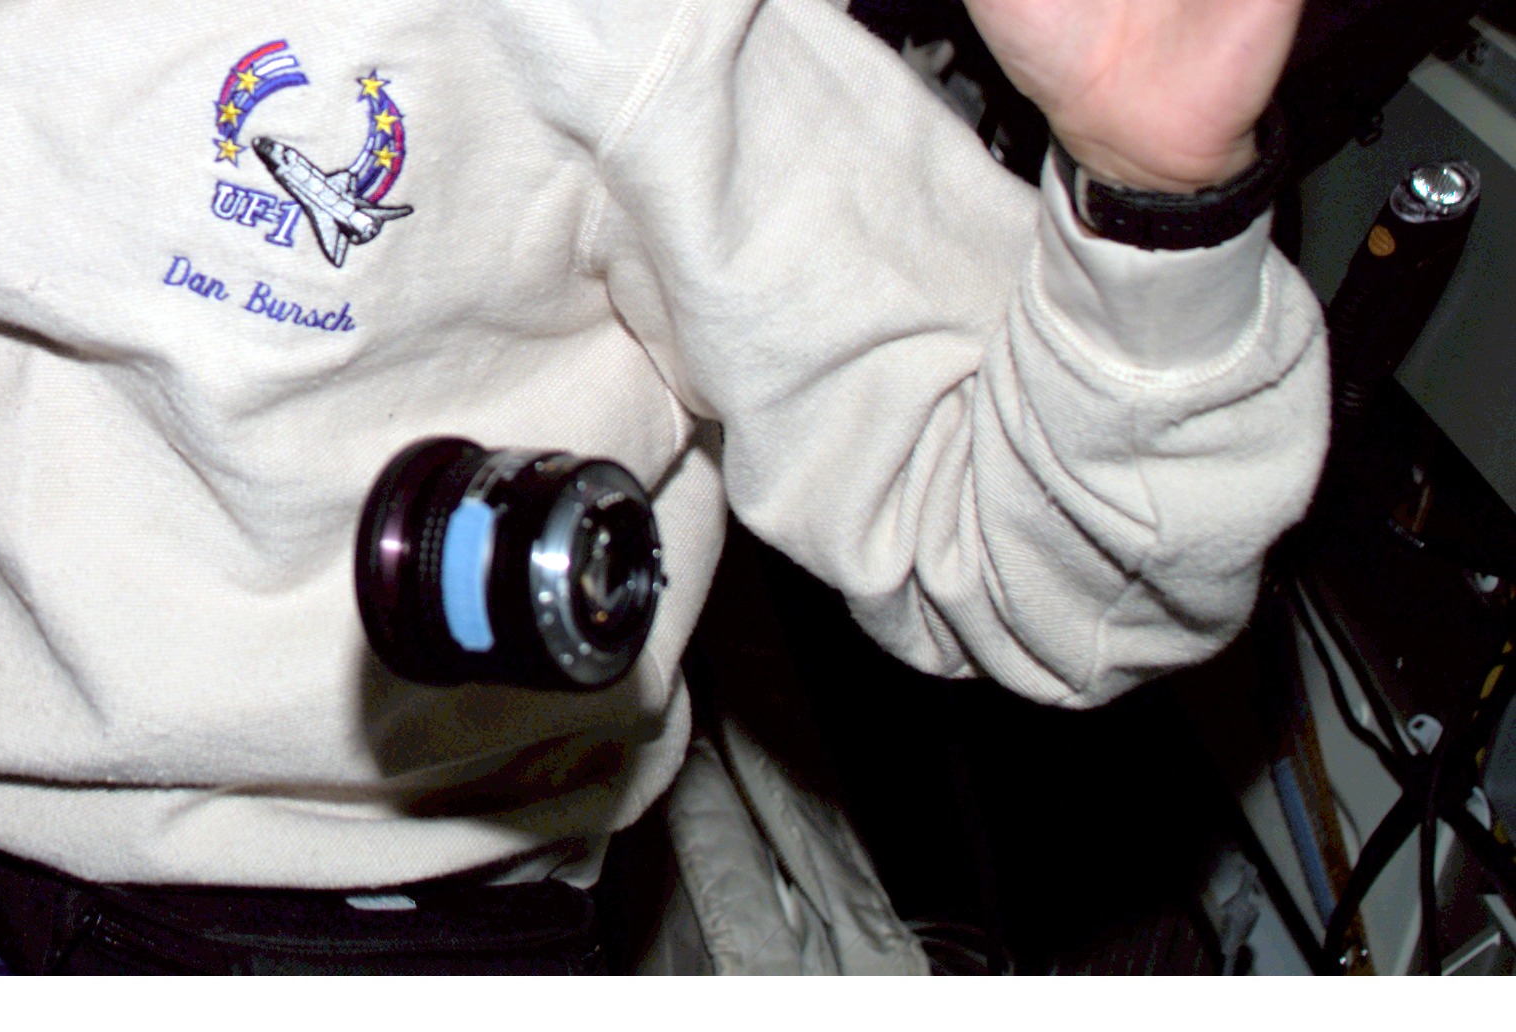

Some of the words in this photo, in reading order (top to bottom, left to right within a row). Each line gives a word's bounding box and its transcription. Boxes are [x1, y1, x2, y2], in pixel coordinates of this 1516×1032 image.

[211, 180, 301, 247] UF-1
[163, 255, 229, 301] Dan
[244, 280, 355, 332] Bursch
